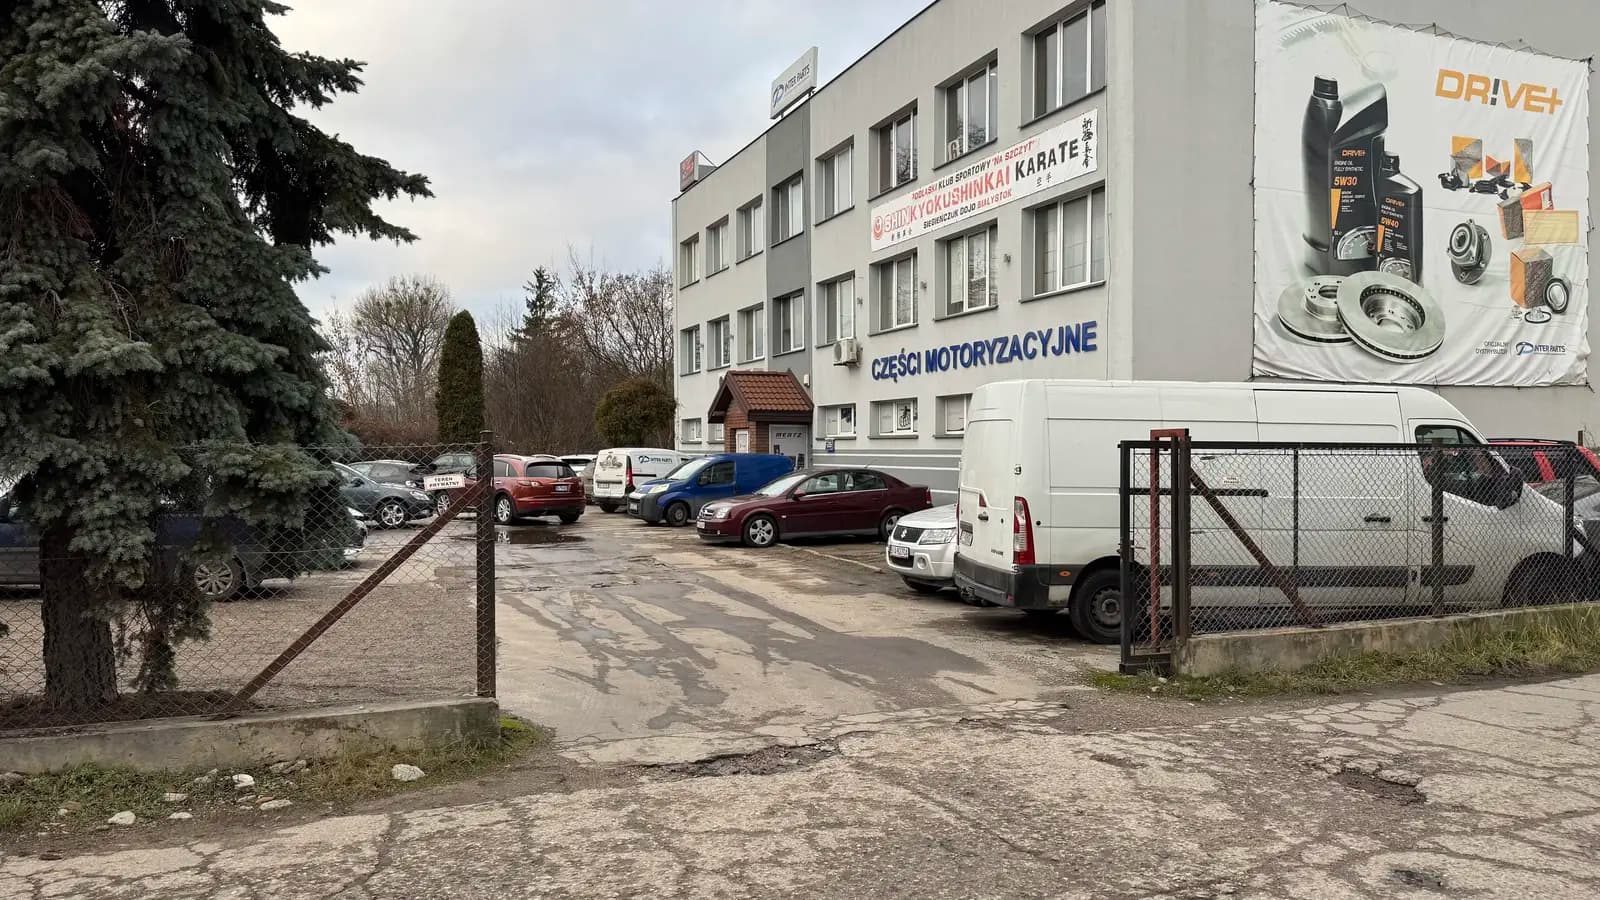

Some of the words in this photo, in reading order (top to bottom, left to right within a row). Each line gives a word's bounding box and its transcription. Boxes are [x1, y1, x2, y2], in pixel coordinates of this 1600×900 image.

[938, 176, 954, 190] KLUB
[955, 160, 991, 182] SPORTOWY
[1015, 138, 1079, 182] KARATE
[1333, 176, 1358, 186] 5W30
[960, 203, 976, 216] DOJO
[872, 347, 921, 383] CZĘŚCI
[925, 320, 1097, 373] MOTORYZACYJNE
